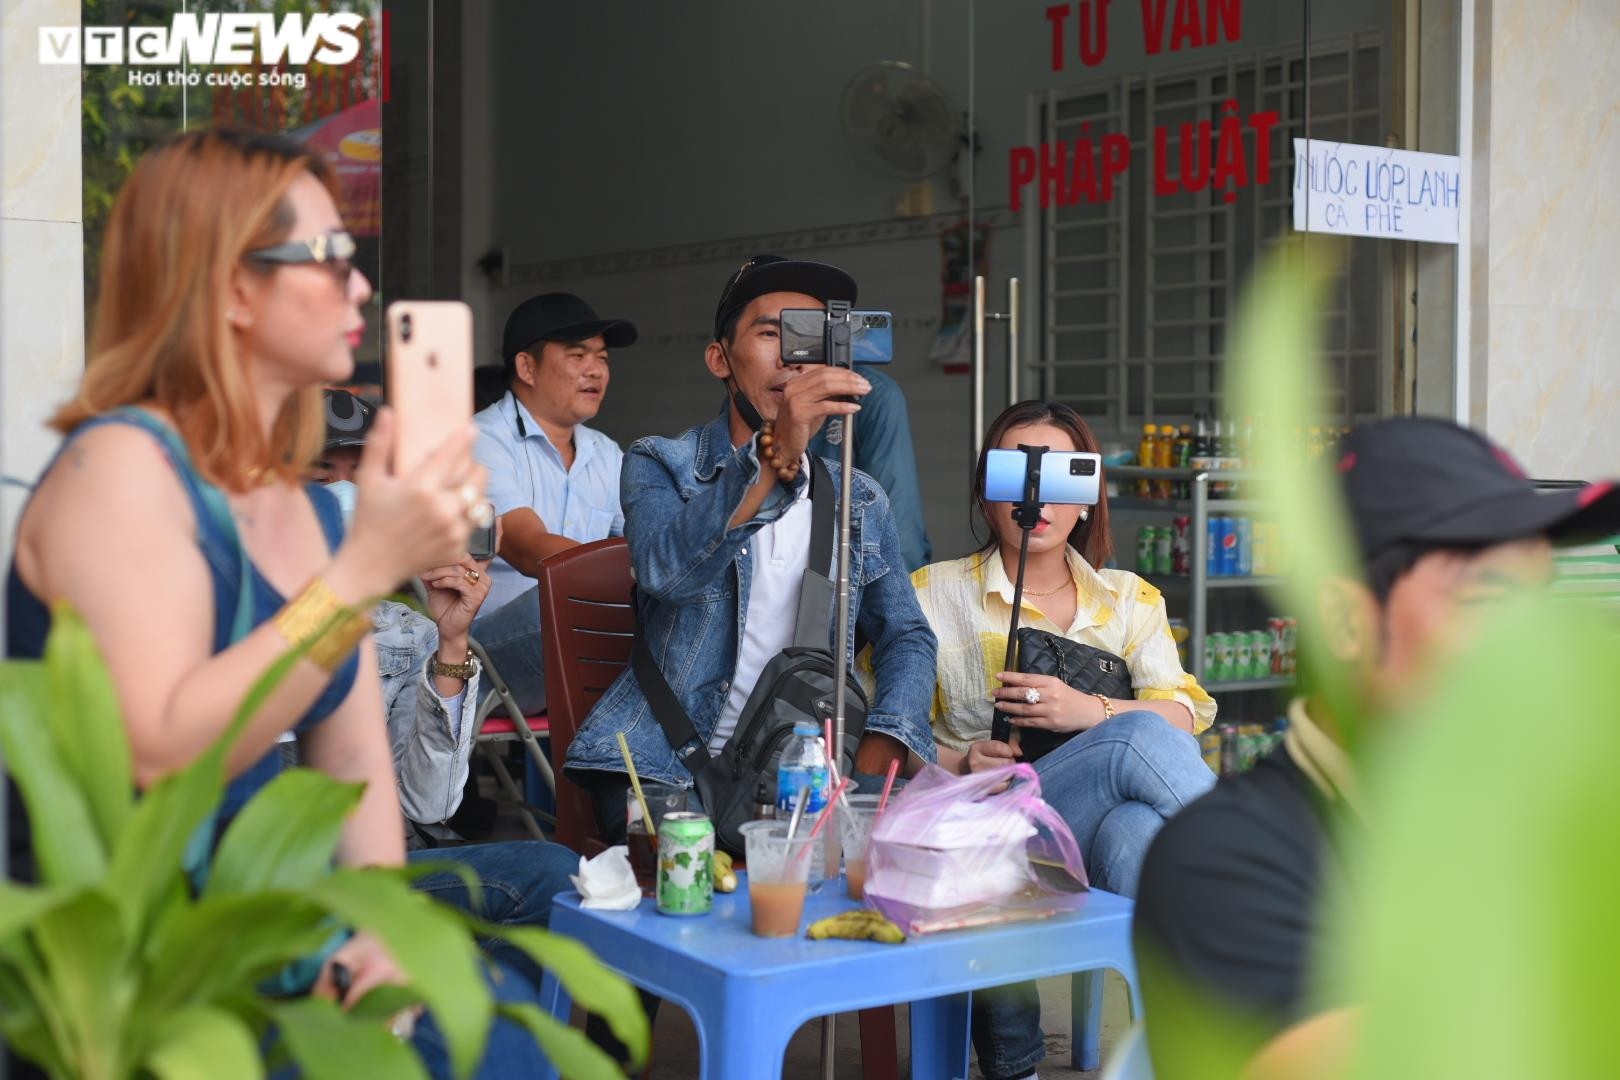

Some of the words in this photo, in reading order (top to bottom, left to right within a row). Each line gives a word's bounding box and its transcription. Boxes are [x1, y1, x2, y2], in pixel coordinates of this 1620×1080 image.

[1010, 121, 1131, 211] PHÁP
[1154, 98, 1280, 203] LUẬT
[1408, 167, 1459, 212] LẠNH
[1325, 197, 1349, 228] CÀ
[1365, 198, 1403, 232] PHÊ
